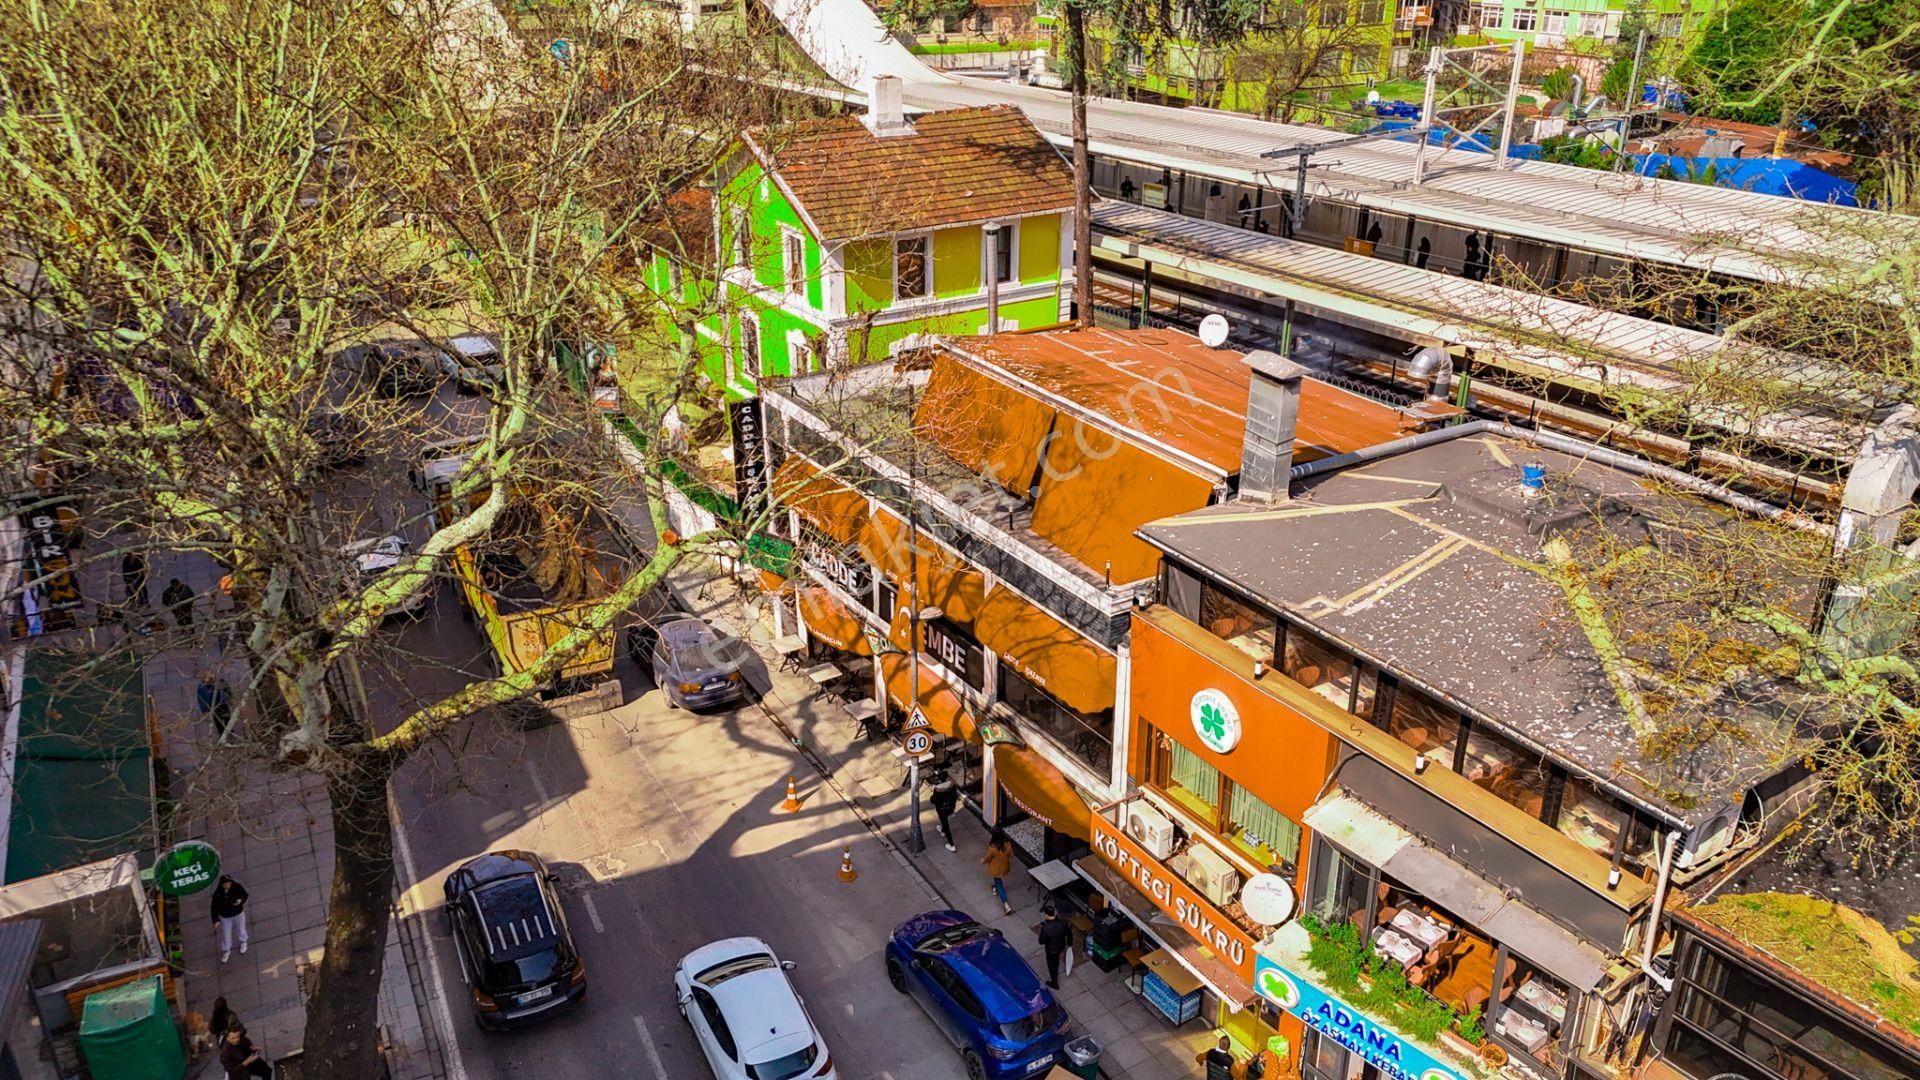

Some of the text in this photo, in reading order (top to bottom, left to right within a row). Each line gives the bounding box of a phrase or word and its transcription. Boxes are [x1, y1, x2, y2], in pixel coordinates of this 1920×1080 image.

[909, 736, 927, 750] 30
[170, 871, 210, 889] TERAS
[173, 861, 202, 879] KEÇİ
[1094, 828, 1246, 966] KÖFTECİ ŞÜKRÜ
[1300, 1006, 1321, 1029] ÖZ
[1317, 999, 1403, 1062] ADANA
